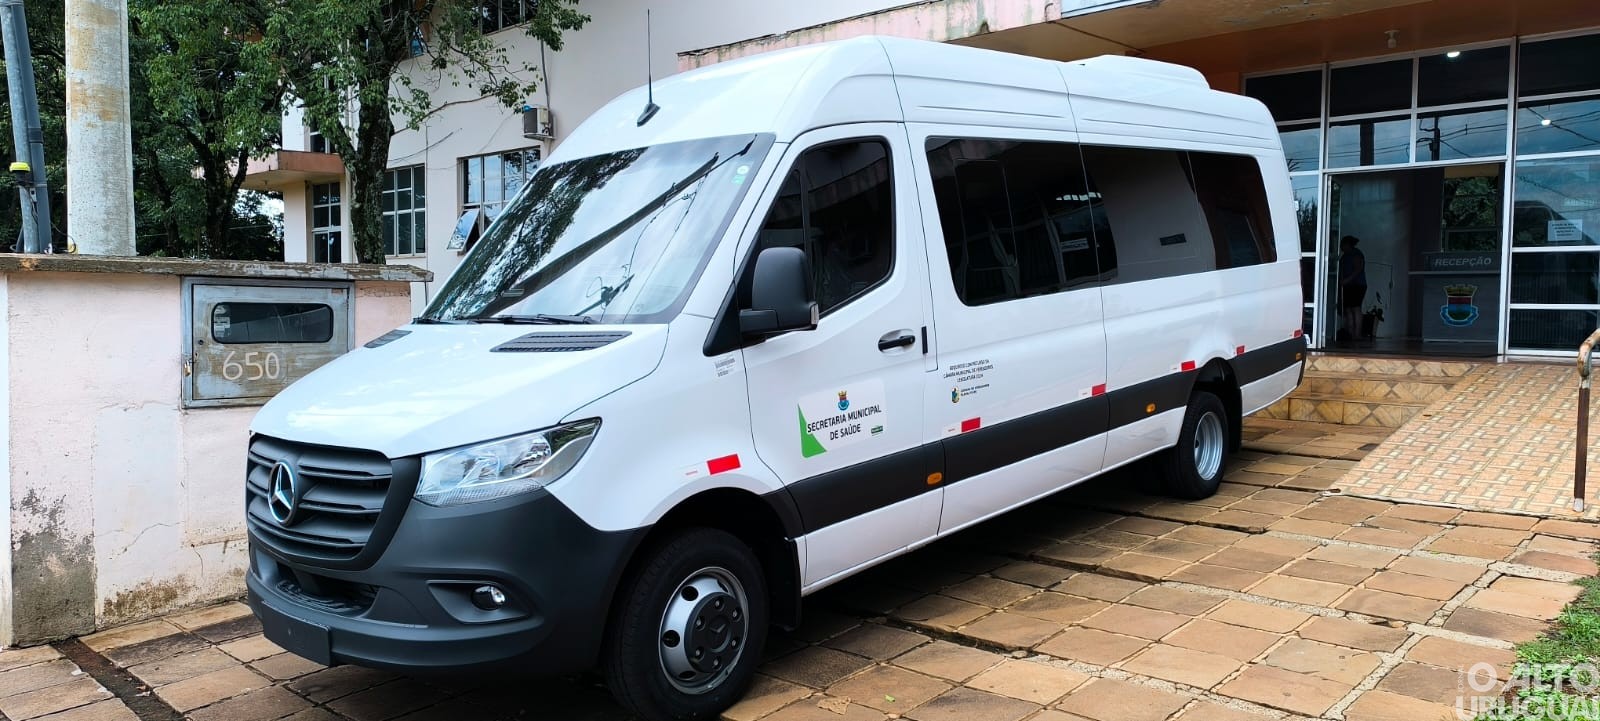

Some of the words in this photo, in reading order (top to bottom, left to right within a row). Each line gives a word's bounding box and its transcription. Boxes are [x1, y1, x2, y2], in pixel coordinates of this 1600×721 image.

[1434, 256, 1492, 267] RECEPÇÃO
[222, 351, 280, 381] 650
[807, 414, 847, 433] SECRETARIA
[847, 404, 882, 421] MUNICIPAL
[829, 431, 839, 441] DE
[839, 423, 861, 438] SAÚDE
